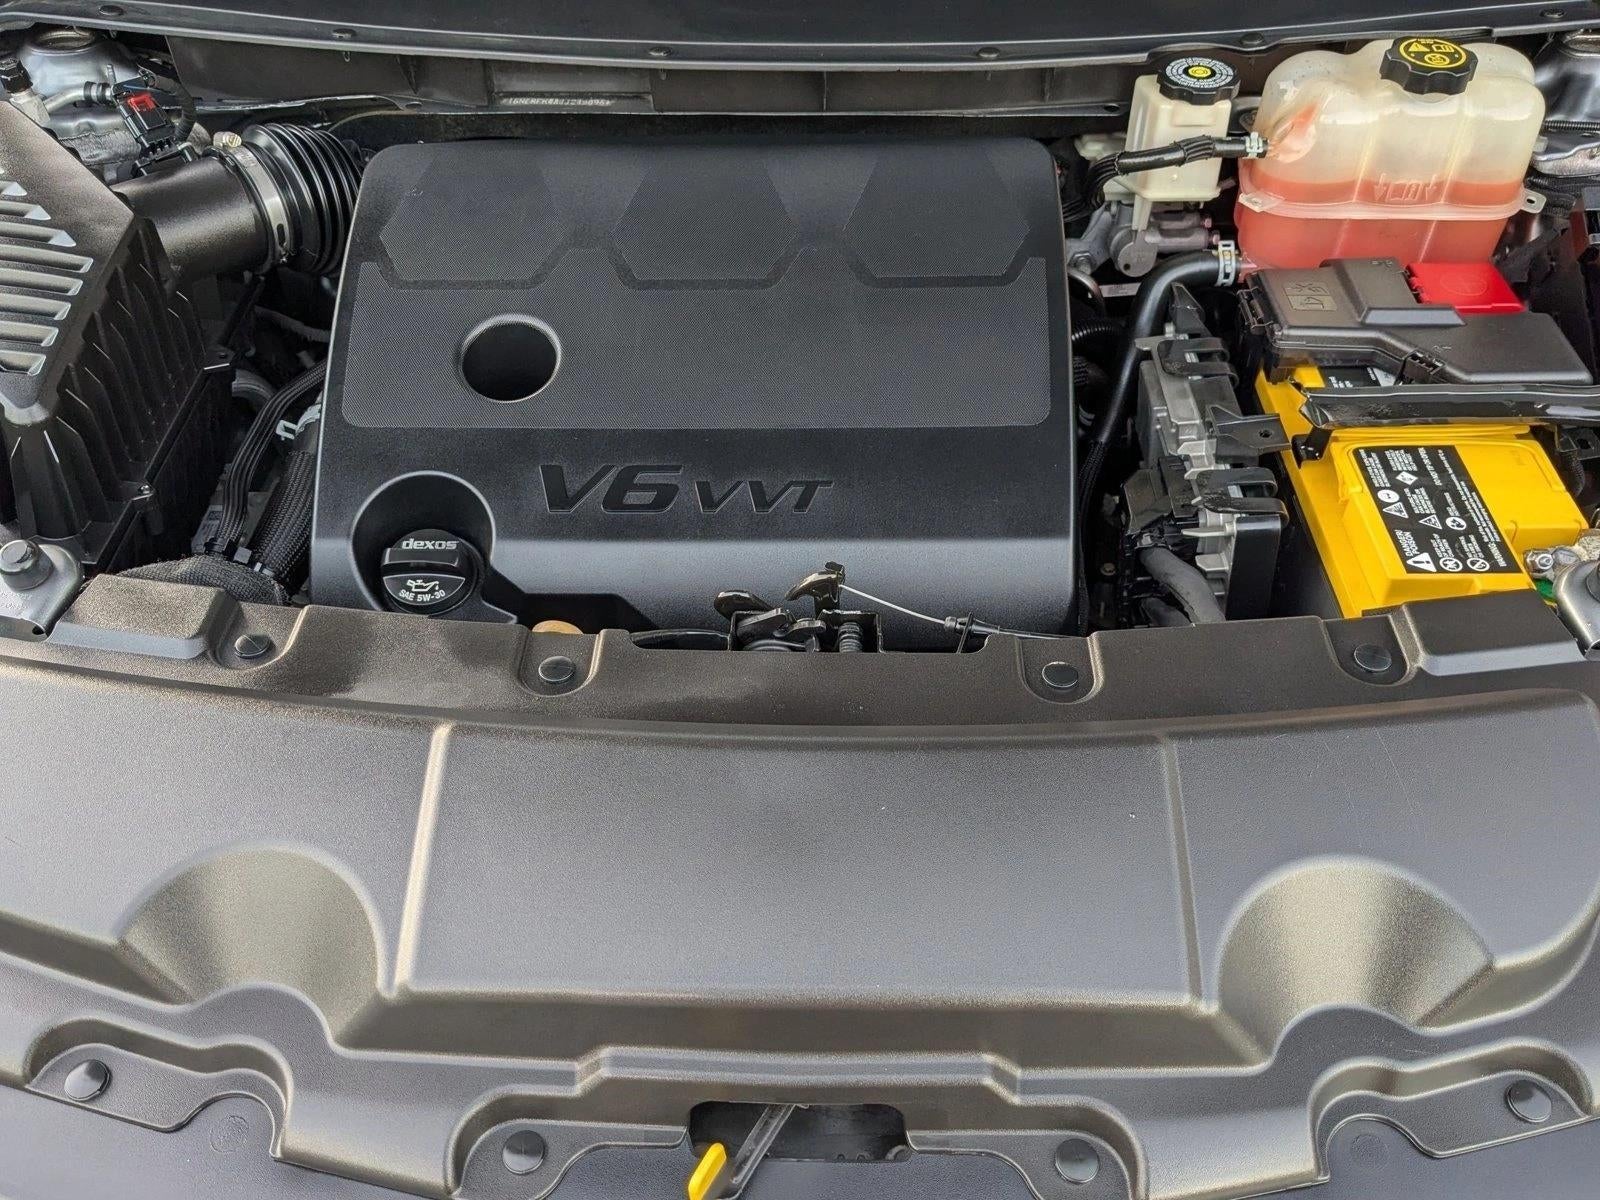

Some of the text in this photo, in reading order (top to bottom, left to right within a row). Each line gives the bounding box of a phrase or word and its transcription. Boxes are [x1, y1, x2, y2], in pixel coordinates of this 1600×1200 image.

[539, 464, 834, 514] V6 VVT
[402, 539, 459, 549] dexos
[1402, 531, 1420, 553] POISON
[399, 590, 446, 602] SAE 5W-30
